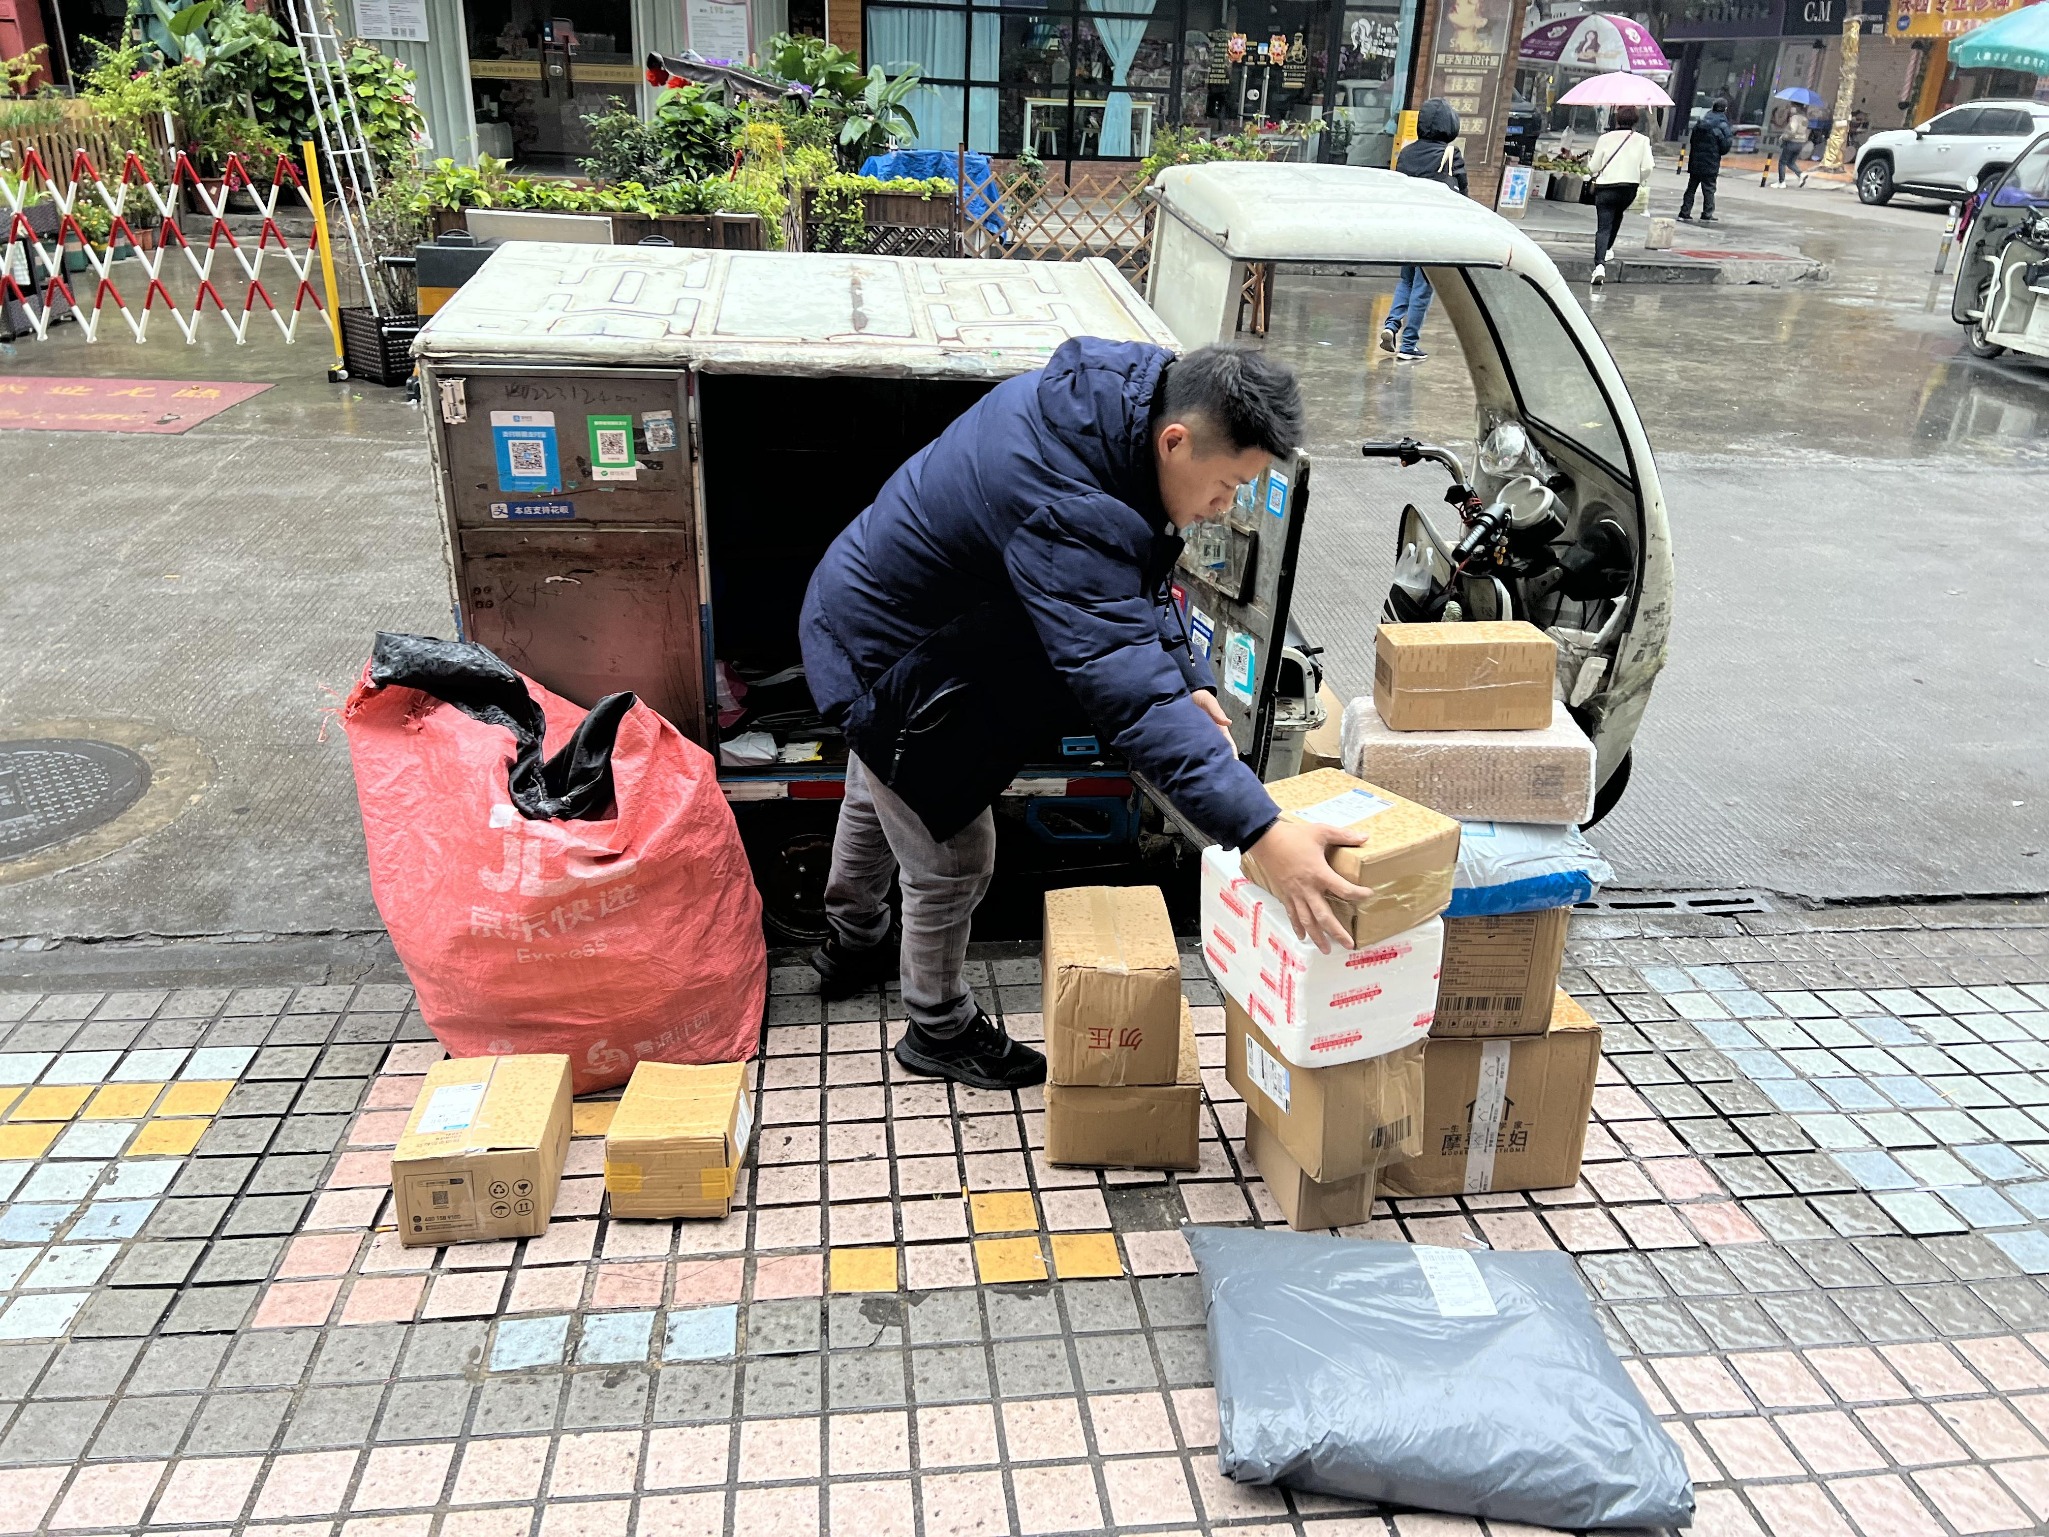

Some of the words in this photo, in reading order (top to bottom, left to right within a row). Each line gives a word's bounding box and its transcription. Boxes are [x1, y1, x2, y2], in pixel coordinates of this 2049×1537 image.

[514, 505, 569, 515] 本店支持花呗
[470, 883, 639, 942] 京东快递
[1088, 1027, 1143, 1051] 勿压
